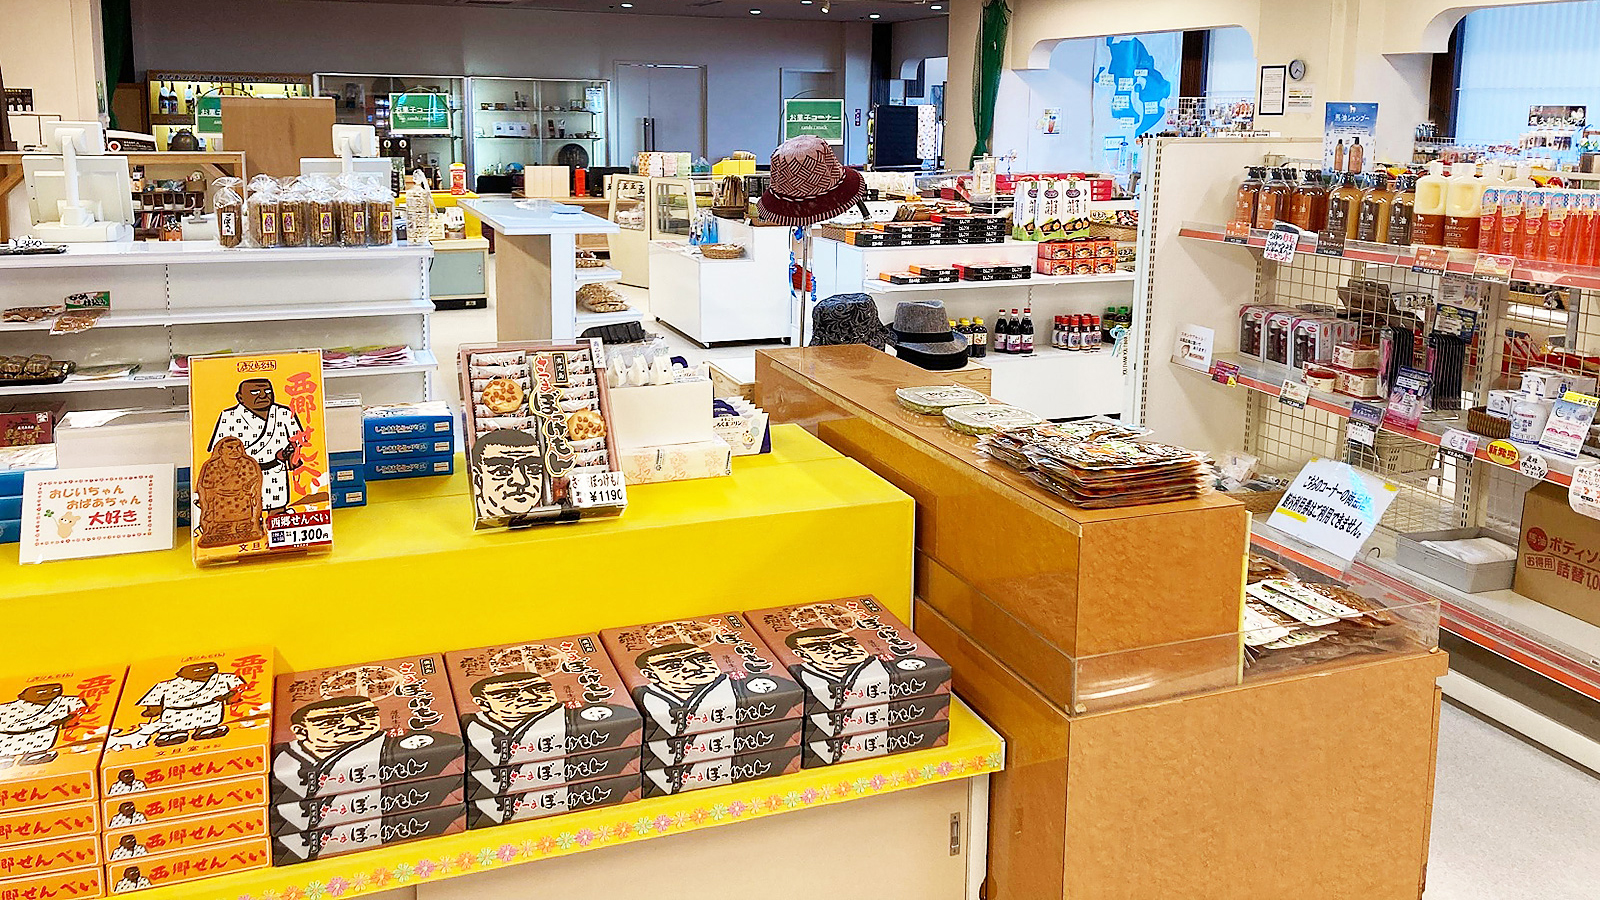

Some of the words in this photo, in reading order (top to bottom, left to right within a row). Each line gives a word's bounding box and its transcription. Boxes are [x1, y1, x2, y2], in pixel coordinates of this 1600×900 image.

[789, 113, 840, 121] お菓子コーナー
[284, 371, 321, 497] 西郷せんべい
[1489, 444, 1517, 461] 新発売
[49, 484, 124, 500] おじいちゃん
[590, 488, 623, 503] ¥1190
[66, 497, 141, 511] おばあちゃん
[88, 510, 138, 526] 大好き
[271, 513, 329, 528] 西郷せんべい
[1549, 537, 1600, 563] ボディソ
[1526, 555, 1553, 569] お得用
[1556, 561, 1600, 591] 詰替1,0
[230, 654, 267, 717] 西郷せんべい
[144, 755, 263, 783] 西郷せんべい
[145, 787, 263, 816] 西郷せんべい
[146, 818, 264, 849] 西郷せんべい
[149, 849, 266, 881] 西郷せんべい
